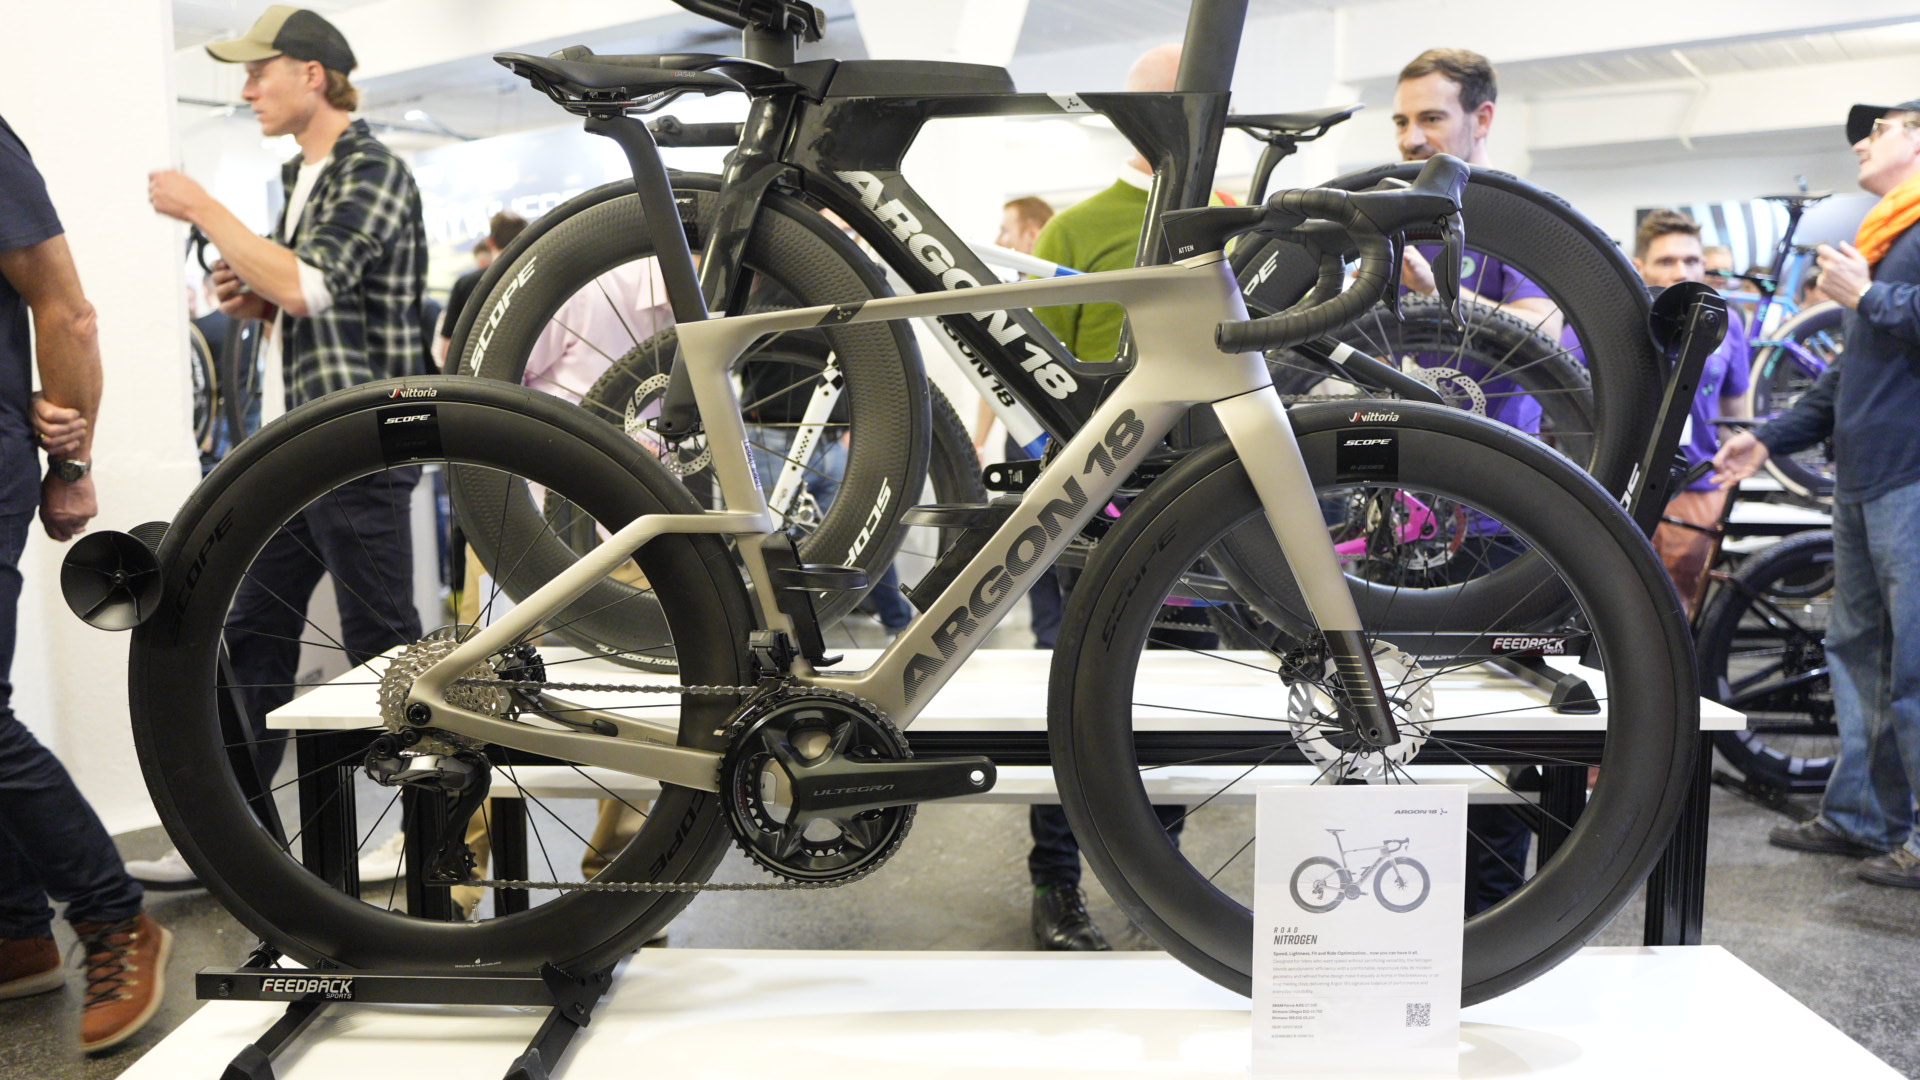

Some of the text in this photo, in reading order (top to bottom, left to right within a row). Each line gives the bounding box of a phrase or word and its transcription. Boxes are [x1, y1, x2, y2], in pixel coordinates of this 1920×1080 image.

[470, 256, 537, 377] SCOPE
[1020, 341, 1078, 400] 18
[401, 387, 438, 399] vittoria
[991, 380, 1016, 407] 18
[384, 413, 431, 425] SCOPE
[1361, 411, 1400, 422] vittoria
[1343, 438, 1392, 447] SCOPE
[903, 408, 1145, 707] ARGON 18
[1492, 637, 1566, 649] FEEDBACK
[813, 784, 895, 797] ULTEGRA
[649, 788, 707, 883] COPE
[1273, 934, 1318, 945] NITROGEN
[261, 978, 353, 994] FEEDBACK
